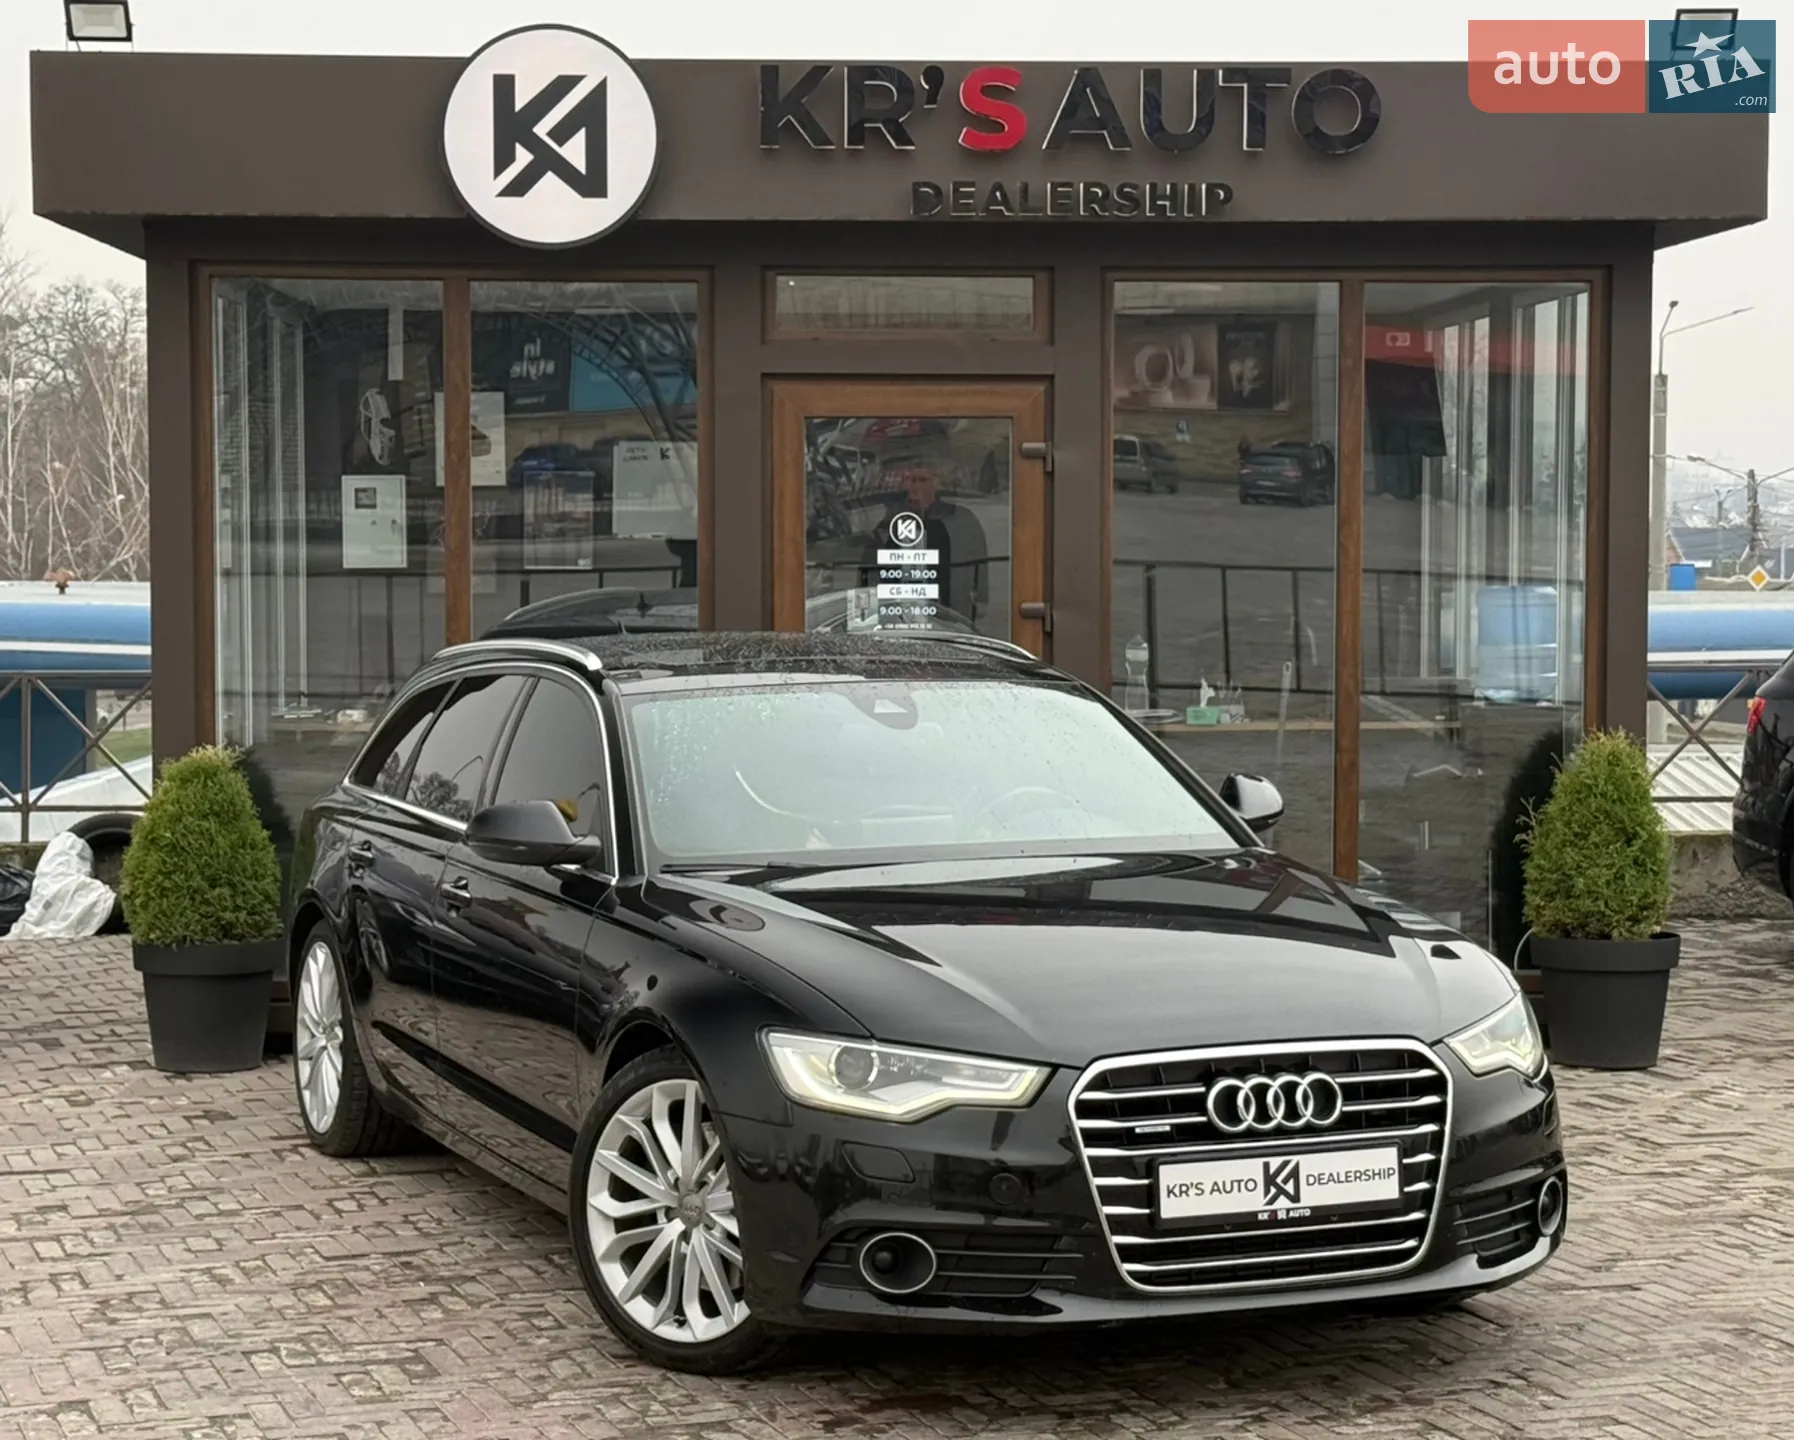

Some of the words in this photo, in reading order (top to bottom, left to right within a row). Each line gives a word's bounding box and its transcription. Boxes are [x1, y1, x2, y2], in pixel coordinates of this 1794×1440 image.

[760, 64, 1028, 152] KR'S
[1041, 67, 1382, 155] AUTO
[910, 181, 1234, 217] DEALERSHIP
[1166, 1180, 1205, 1199] KR'S
[1209, 1177, 1258, 1196] AUTO
[1306, 1166, 1397, 1187] DEALERSHIP
[1288, 1208, 1311, 1218] AUTO
